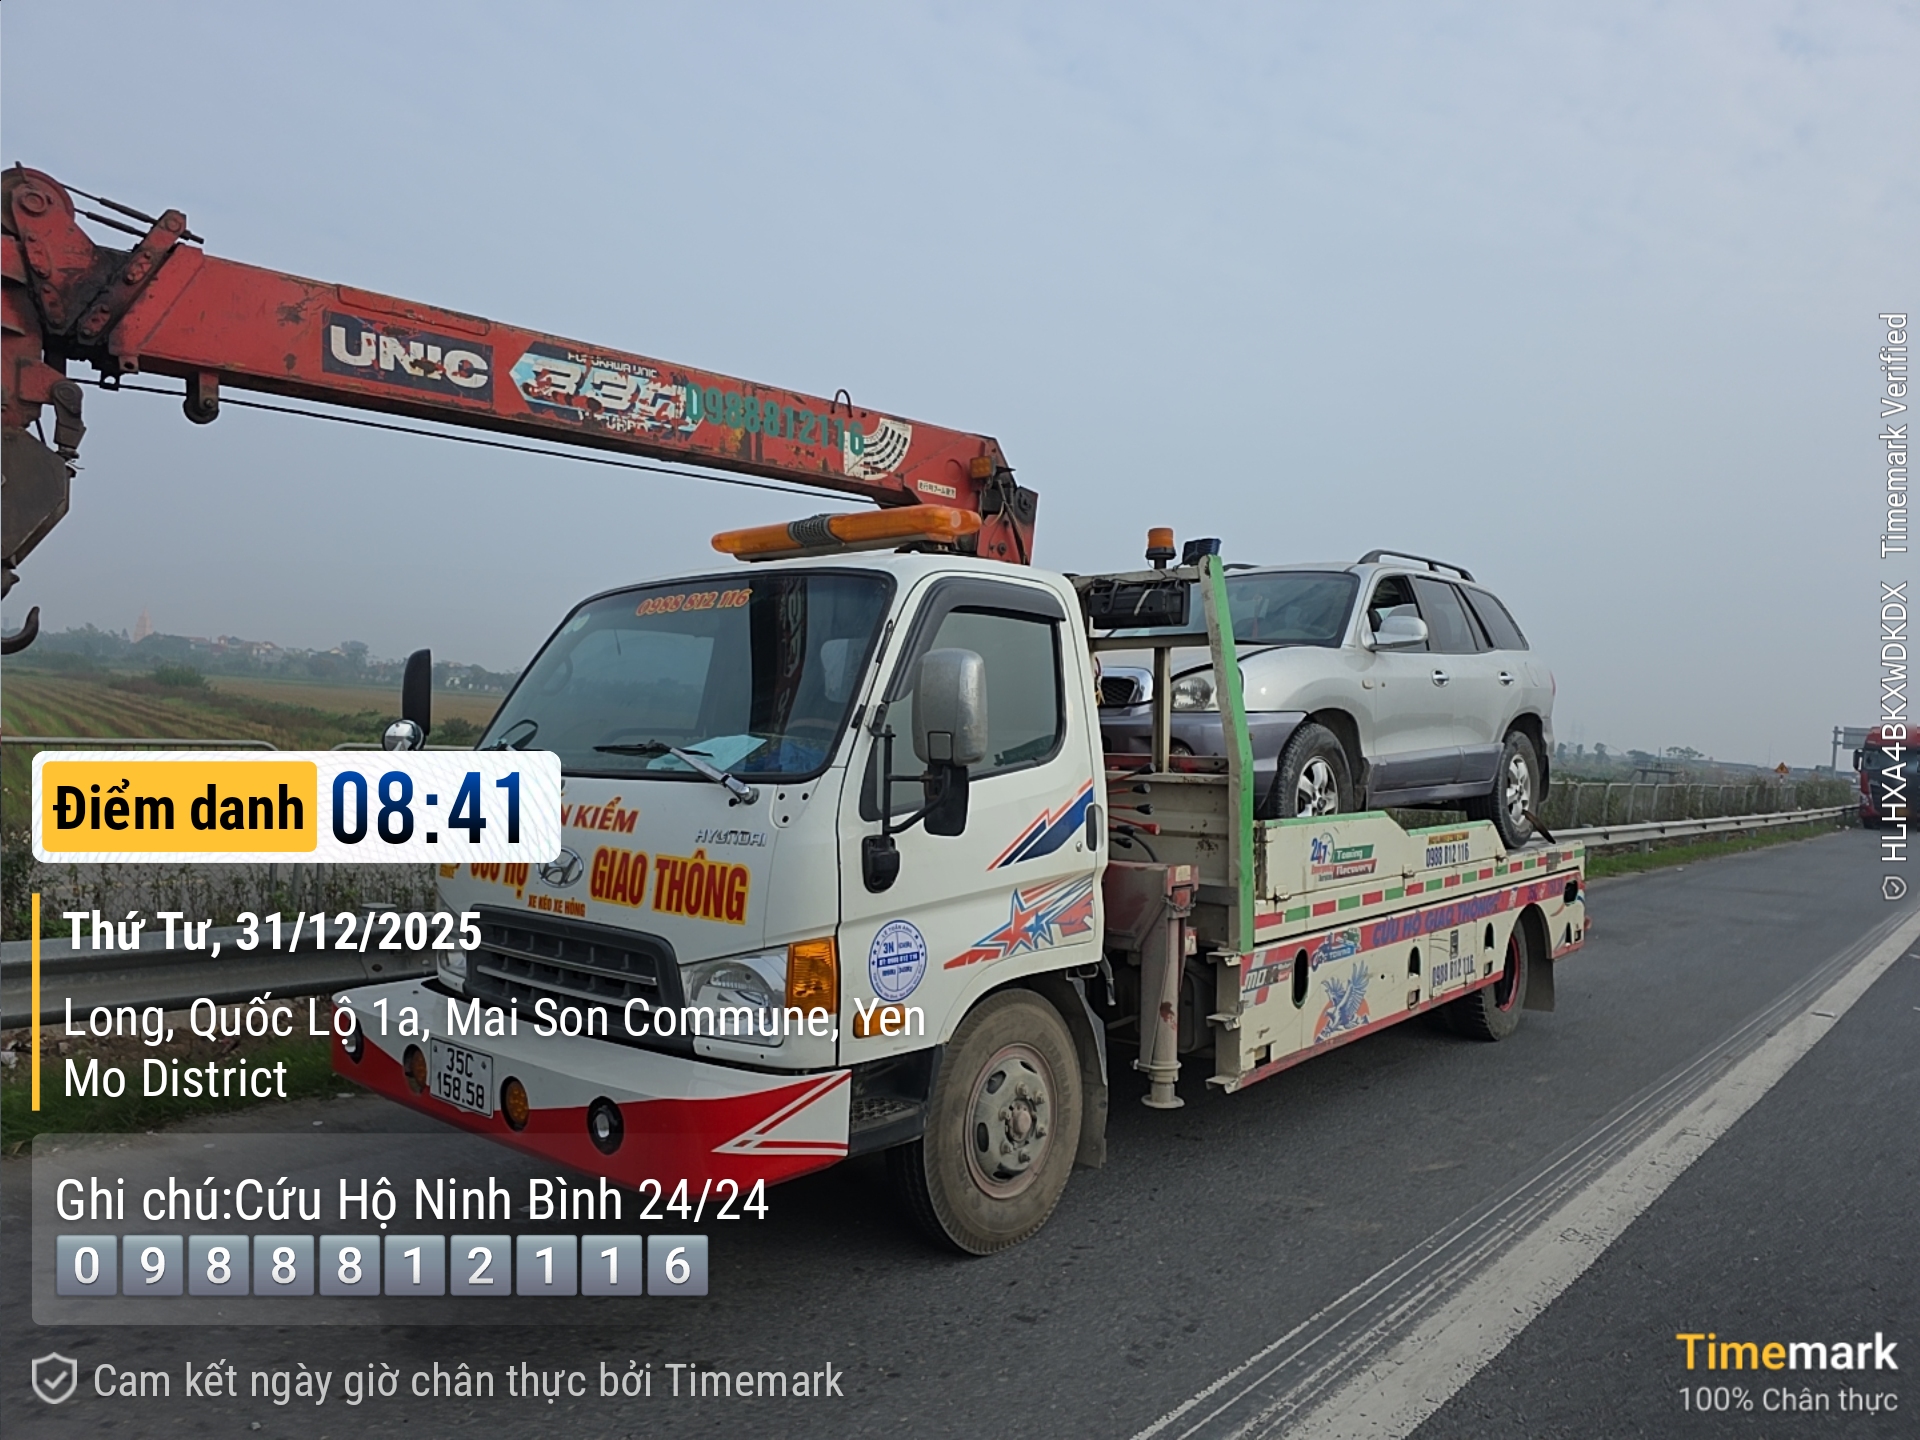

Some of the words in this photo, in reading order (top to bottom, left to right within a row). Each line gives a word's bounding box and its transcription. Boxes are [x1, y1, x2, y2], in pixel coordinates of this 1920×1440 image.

[330, 325, 489, 388] UNIC
[686, 382, 864, 456] 0988812116
[636, 594, 685, 616] 0988
[682, 591, 718, 611] 812
[717, 588, 753, 608] 116
[695, 829, 767, 847] HYUNDAI
[590, 847, 649, 906] GIAO
[654, 849, 749, 922] THÔNG
[446, 1047, 475, 1078] 35C
[437, 1072, 485, 1109] 158.58
